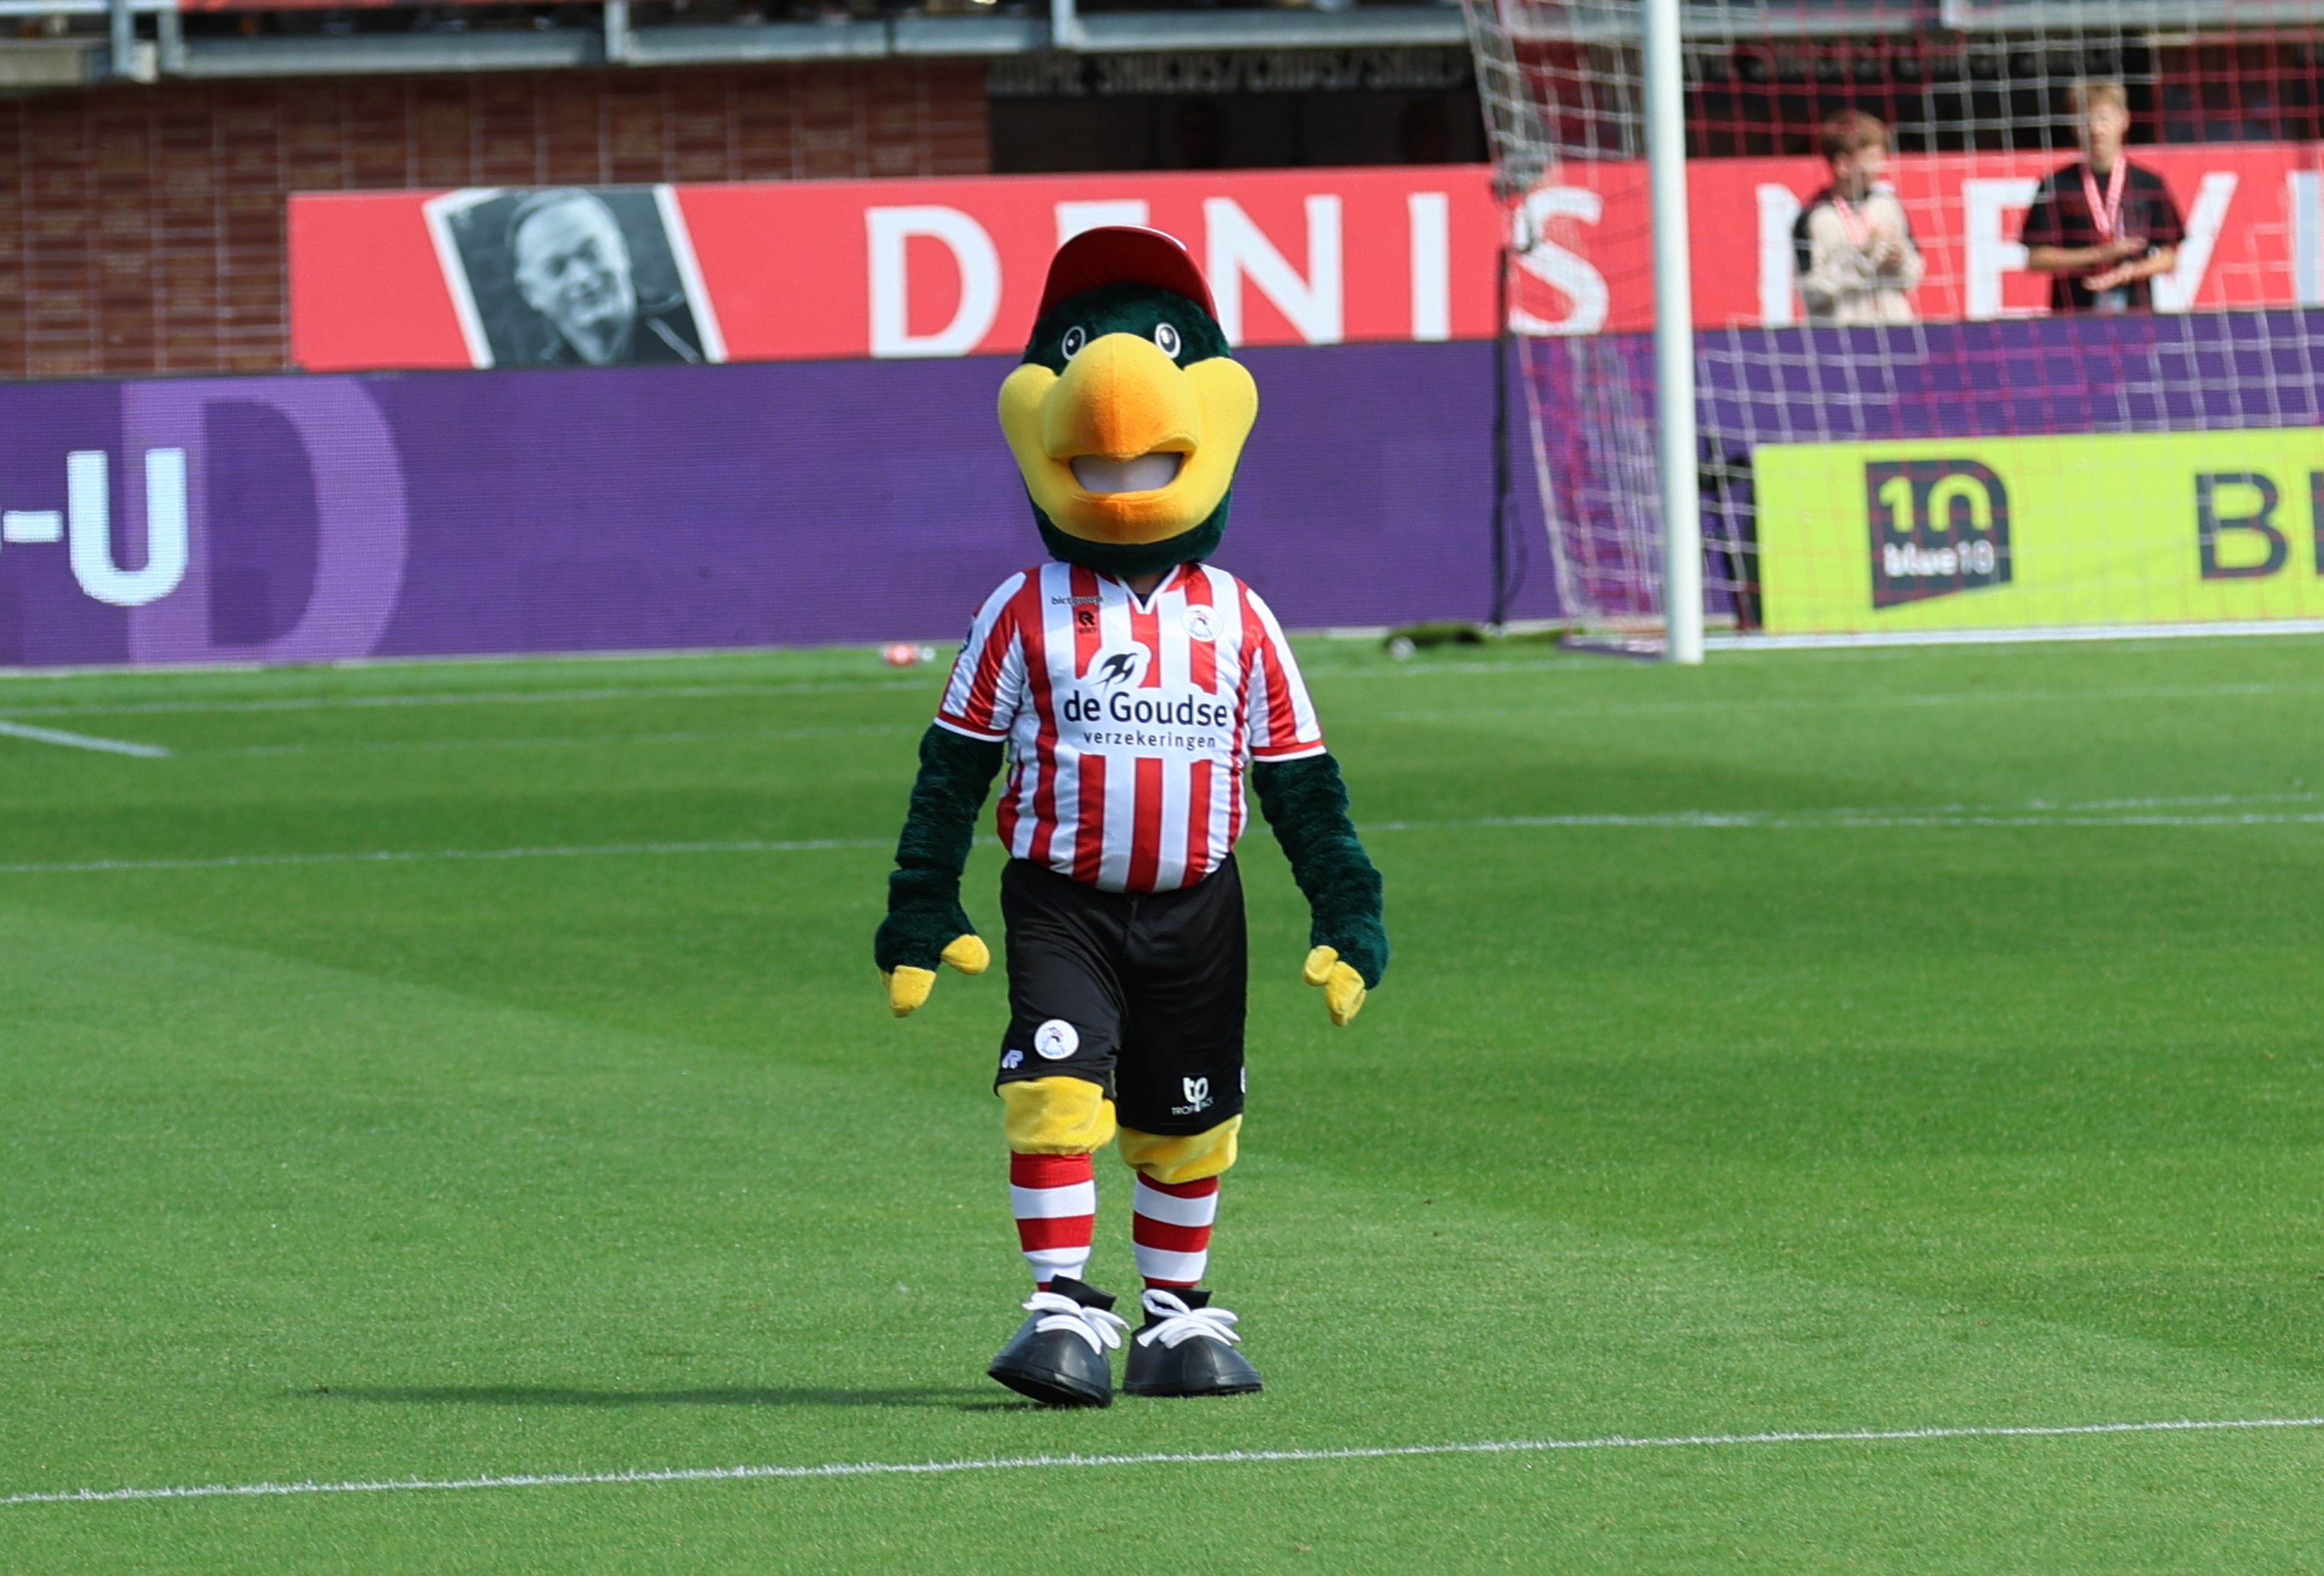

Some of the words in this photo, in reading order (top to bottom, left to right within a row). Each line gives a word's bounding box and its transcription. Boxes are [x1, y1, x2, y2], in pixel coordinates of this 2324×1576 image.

[2193, 470, 2324, 581] B
[1883, 539, 1995, 578] blue10
[1063, 689, 1101, 722] de
[1109, 691, 1228, 727] Goudse
[1083, 730, 1216, 751] verzekeringen
